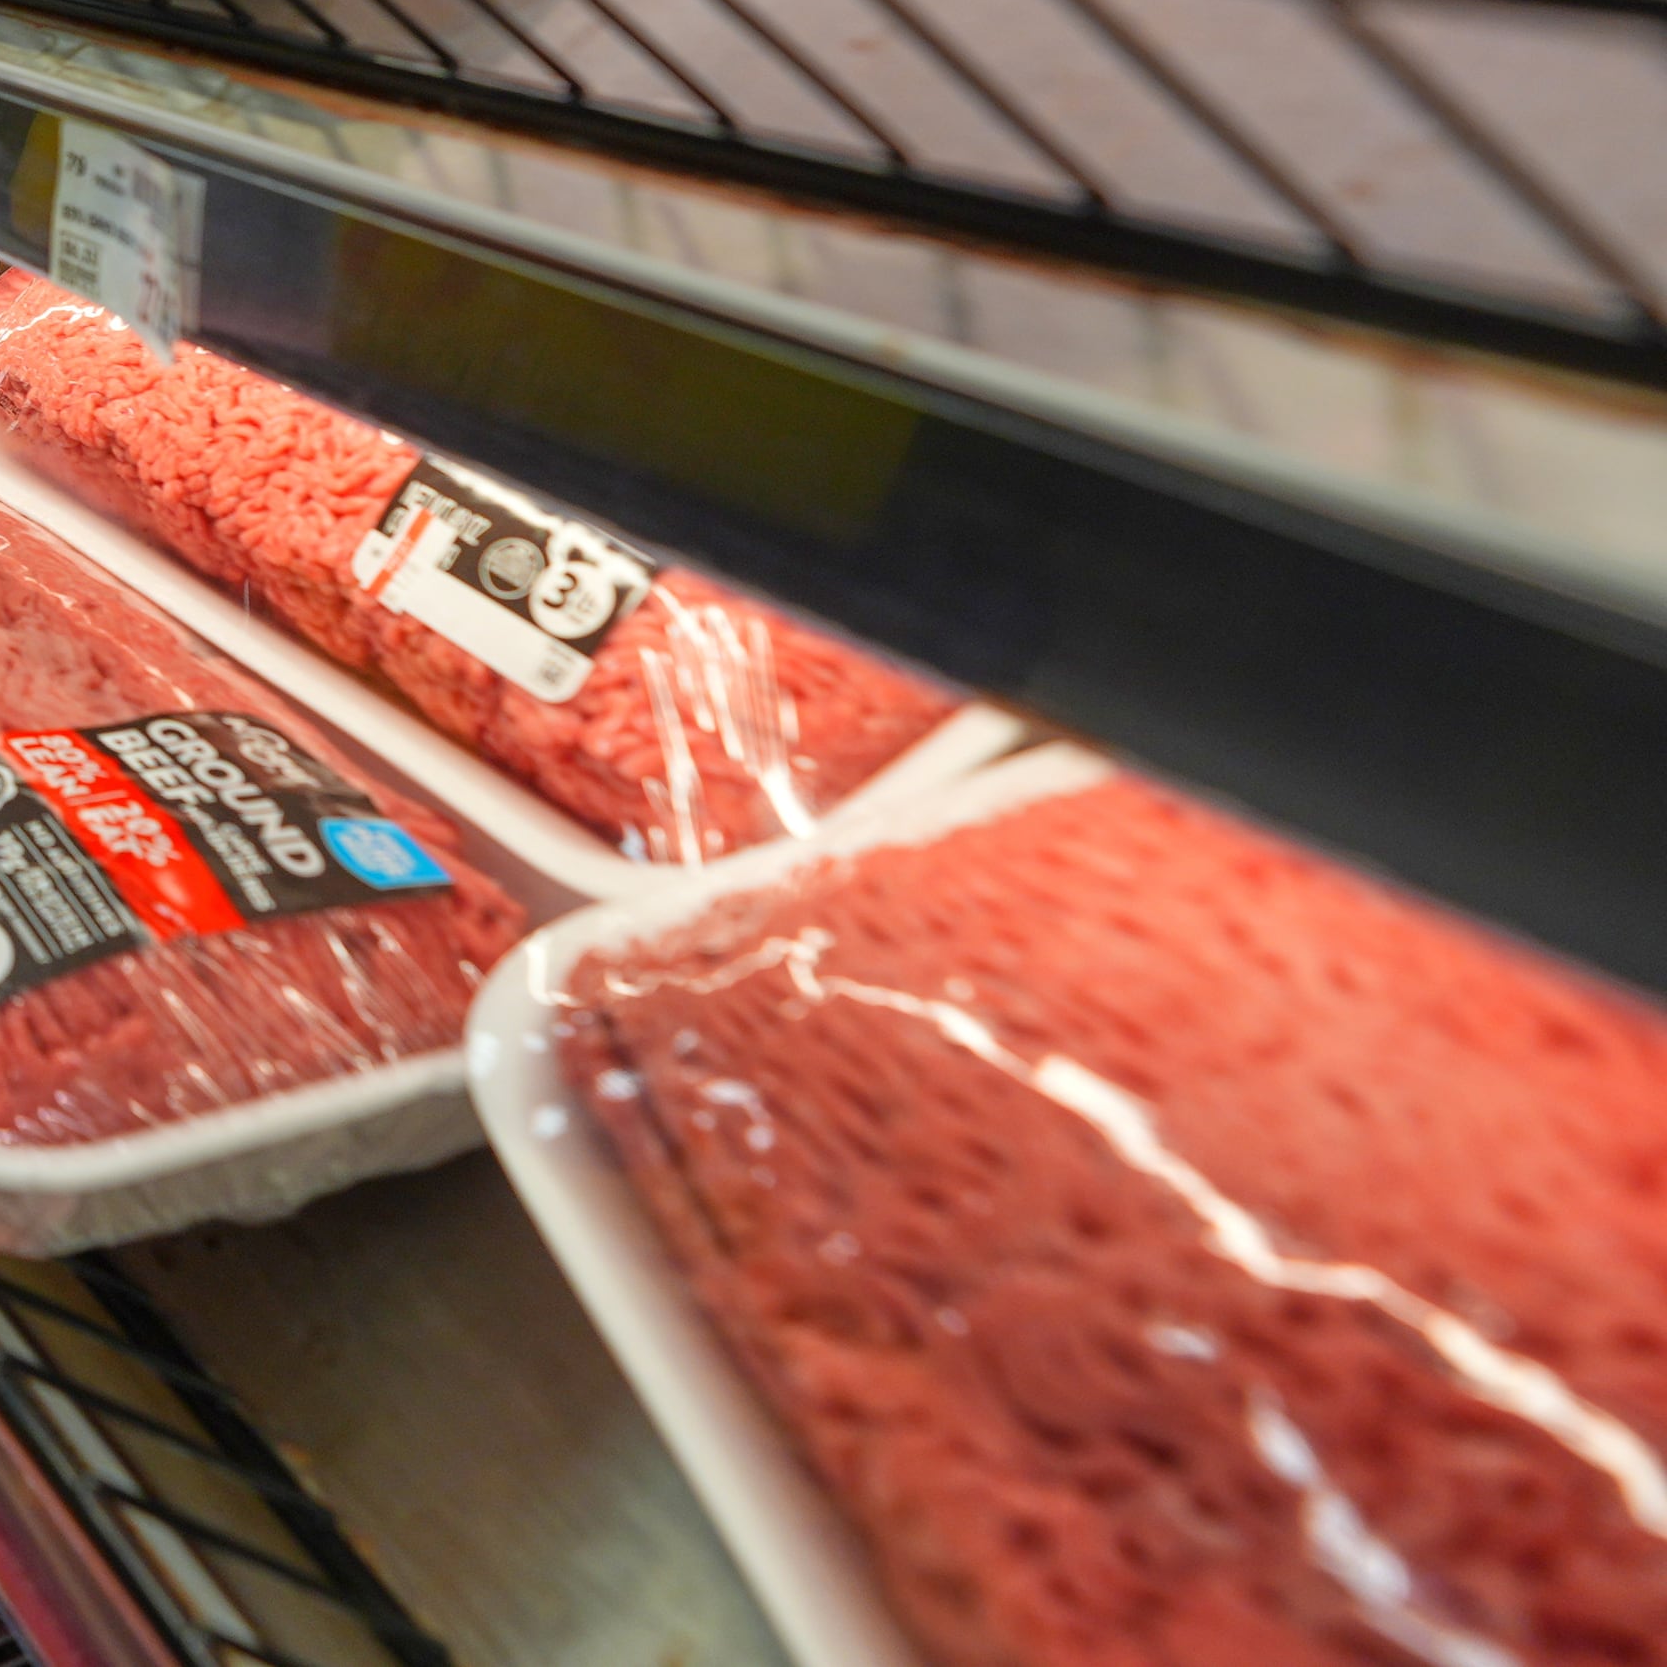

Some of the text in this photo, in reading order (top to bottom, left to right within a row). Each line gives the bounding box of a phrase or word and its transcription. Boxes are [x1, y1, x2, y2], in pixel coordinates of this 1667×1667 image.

[542, 571, 578, 609] 3
[8, 735, 92, 798] LEAN
[98, 727, 217, 807] BEEF
[146, 718, 327, 879] GROUND
